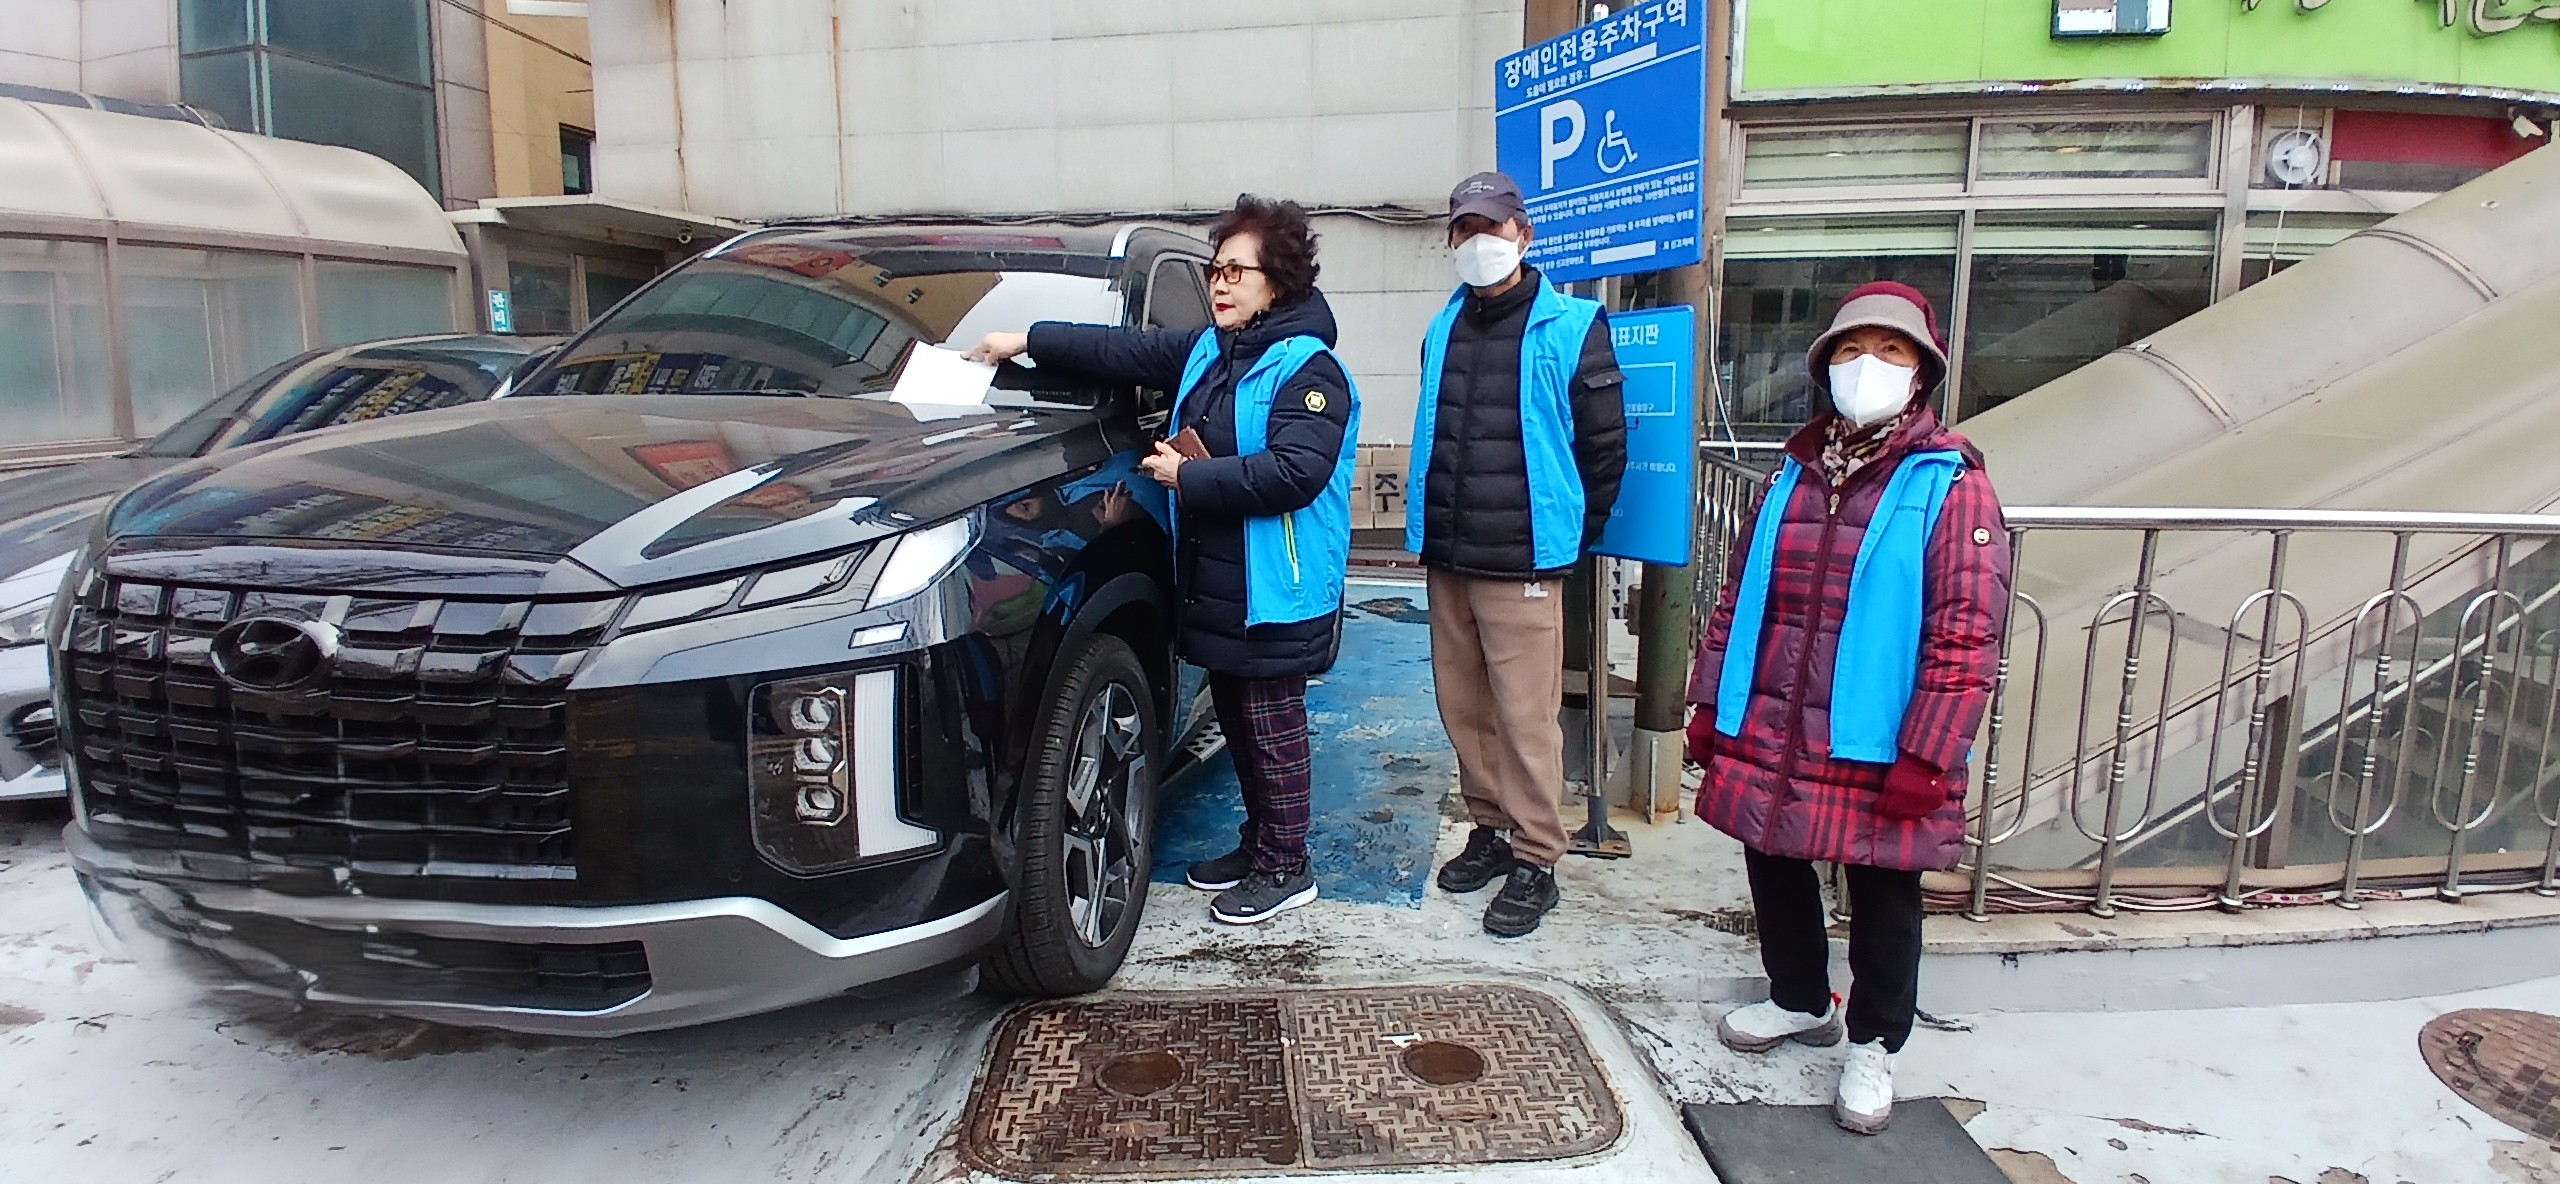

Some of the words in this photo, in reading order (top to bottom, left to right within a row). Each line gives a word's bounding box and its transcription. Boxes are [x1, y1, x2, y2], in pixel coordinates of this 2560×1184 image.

[1504, 0, 1688, 88] 장애인전용주차구역
[1541, 99, 1586, 190] P
[492, 292, 507, 332] 관리
